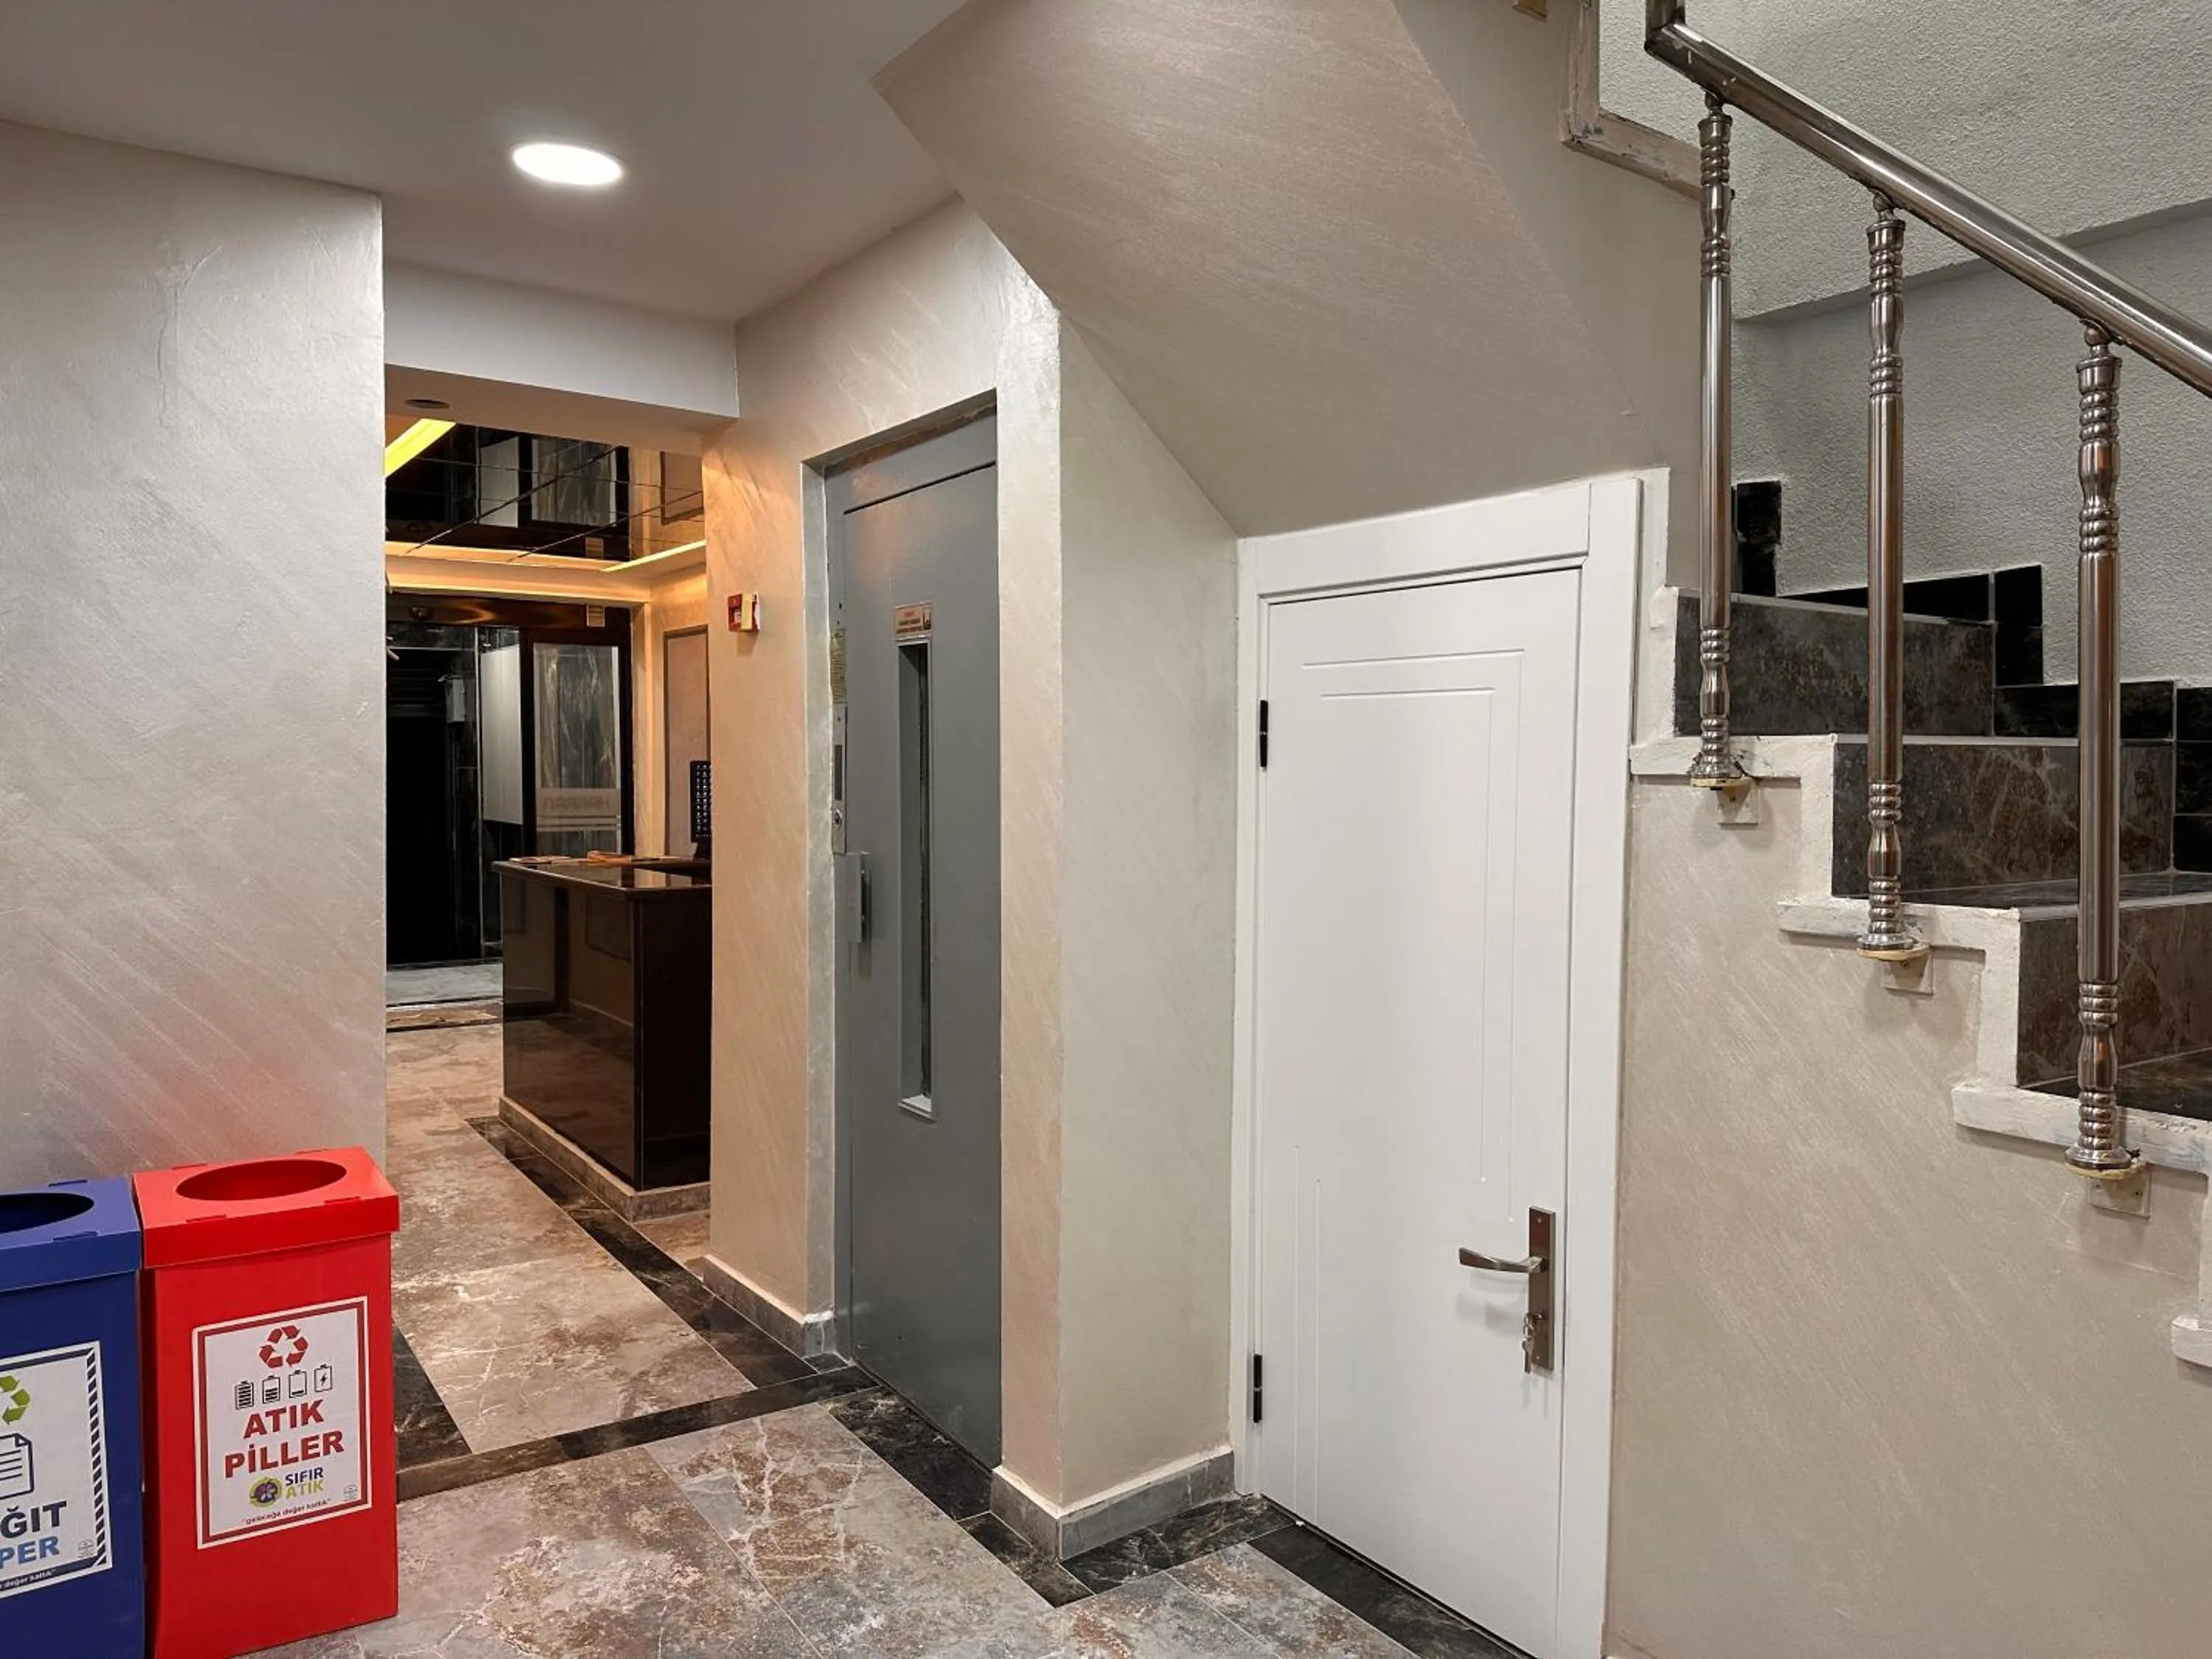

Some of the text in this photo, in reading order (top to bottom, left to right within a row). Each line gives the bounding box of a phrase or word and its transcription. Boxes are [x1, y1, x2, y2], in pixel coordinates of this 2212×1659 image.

[243, 1399, 324, 1439] ATIK
[225, 1430, 344, 1478] PİLLER
[285, 1467, 324, 1486] SIFIR
[285, 1479, 324, 1499] ATIK
